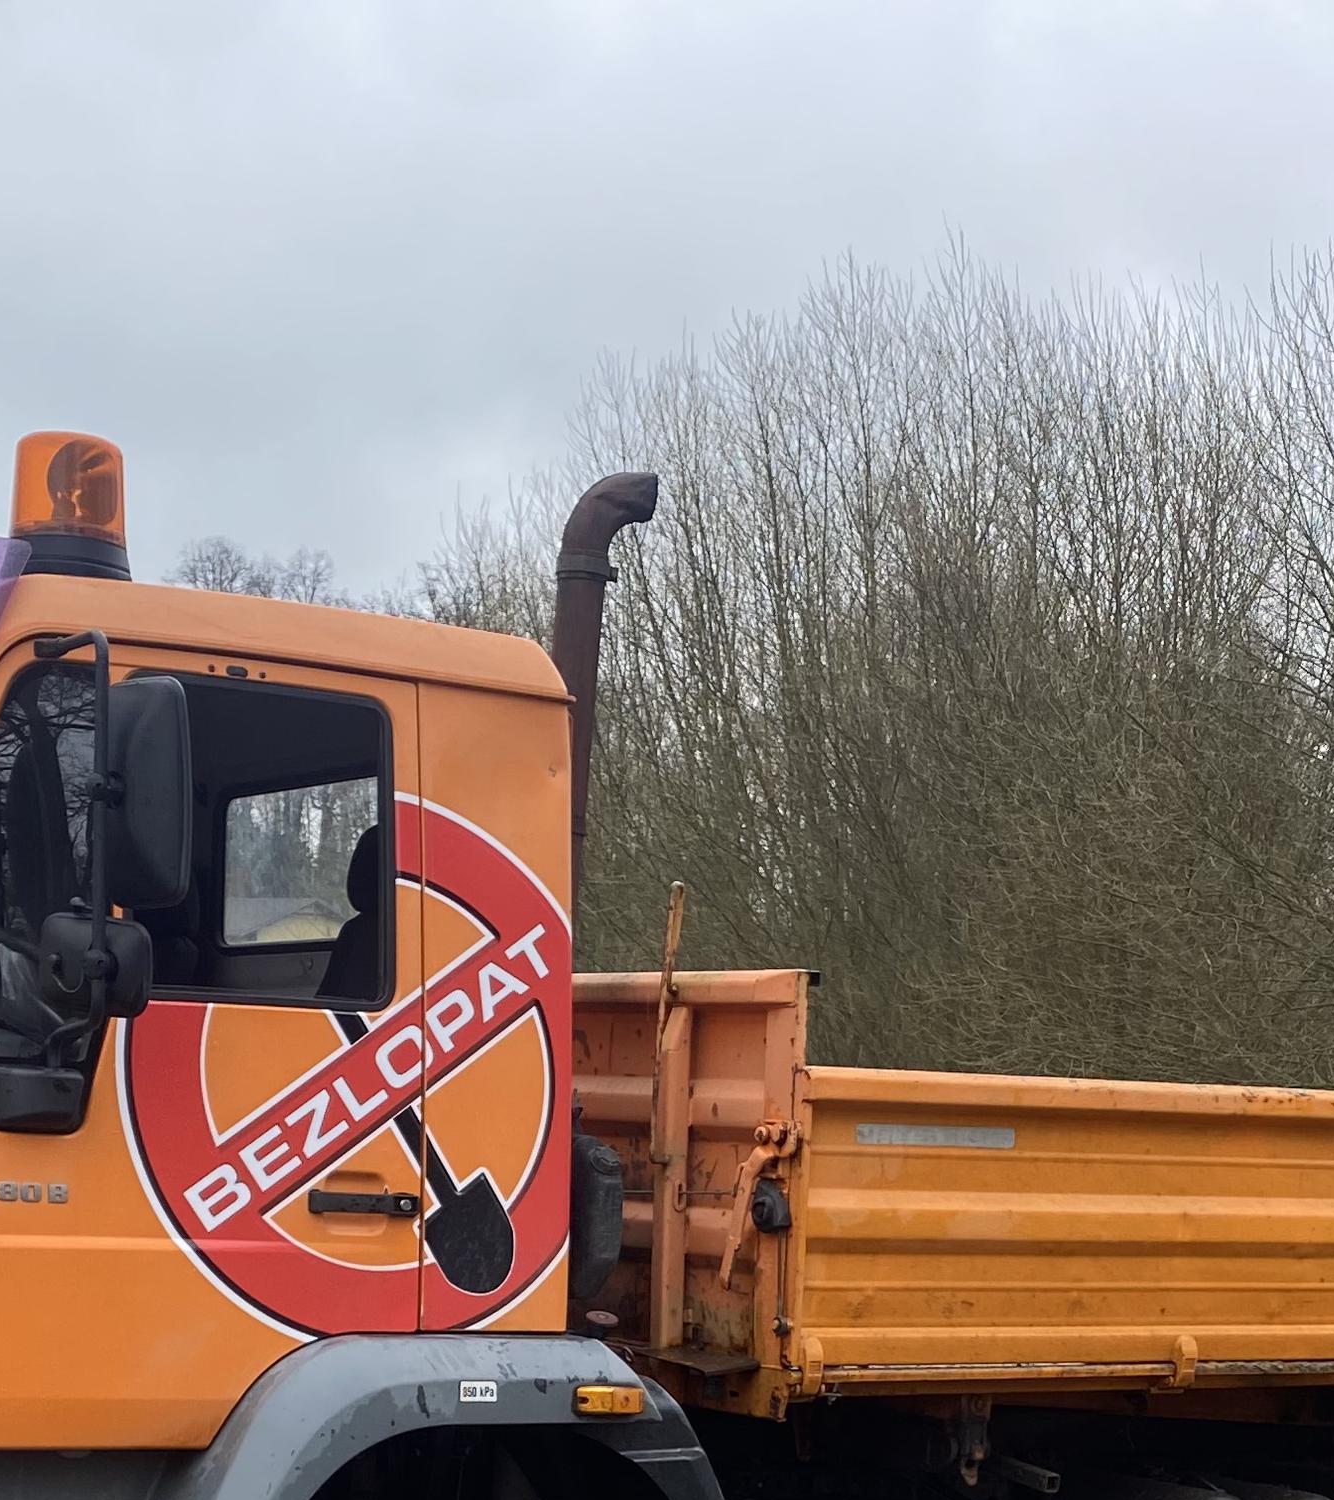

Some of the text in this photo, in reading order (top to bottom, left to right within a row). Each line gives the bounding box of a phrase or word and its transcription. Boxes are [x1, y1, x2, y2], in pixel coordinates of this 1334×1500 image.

[183, 923, 550, 1233] BEZLOPAT
[48, 1183, 69, 1204] B
[479, 1386, 495, 1398] kPa
